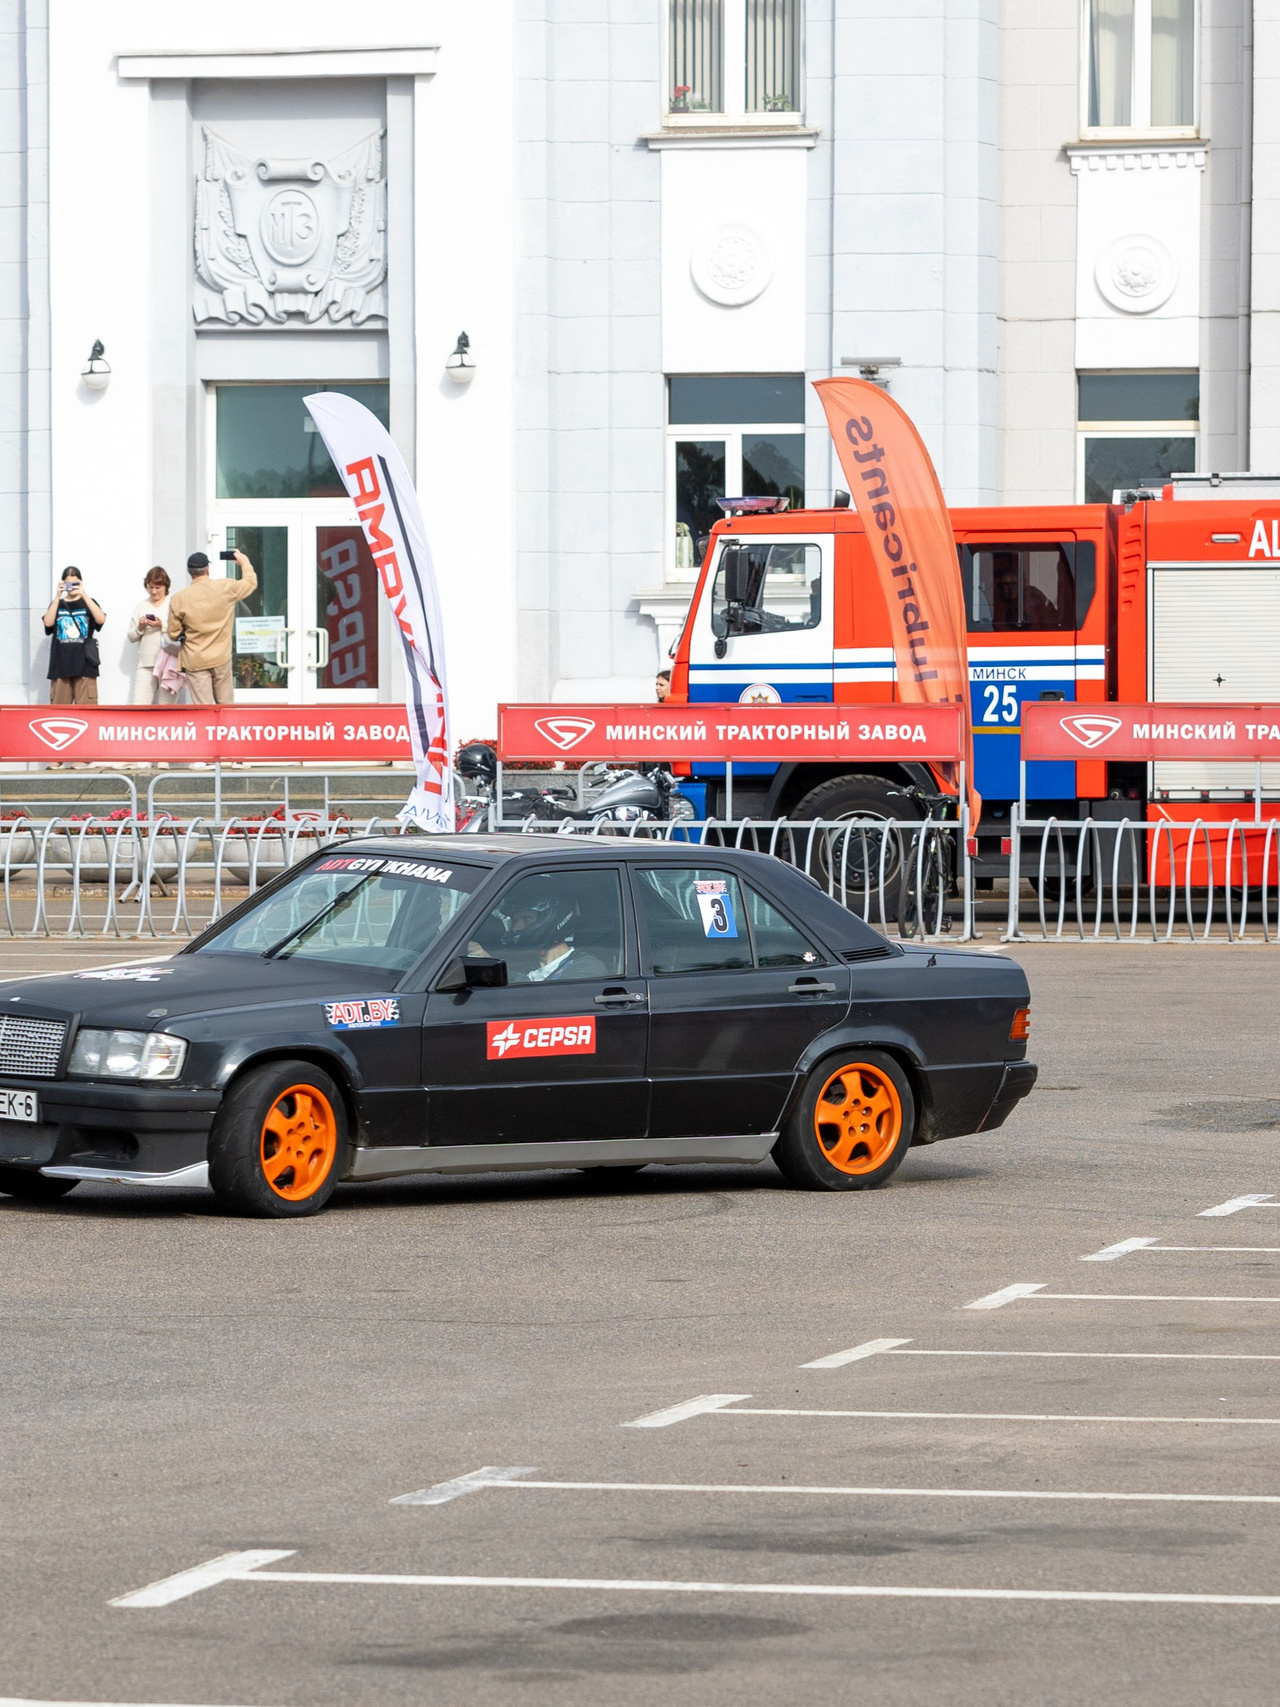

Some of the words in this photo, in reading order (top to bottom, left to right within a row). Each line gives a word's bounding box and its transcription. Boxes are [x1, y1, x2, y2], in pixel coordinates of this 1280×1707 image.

[972, 667, 1027, 680] МИНСК
[982, 684, 1018, 722] 25
[98, 721, 197, 742] МИНСКИЙ
[205, 721, 335, 742] ТРАКТОРНЫЙ
[343, 724, 409, 742] ЗАВОД
[606, 720, 707, 741] МИНСКИЙ
[716, 721, 850, 741] ТРАКТОРНЫЙ
[858, 724, 926, 743] ЗАВОД
[1132, 721, 1236, 740] МИНСКИЙ
[710, 898, 728, 932] 3
[331, 999, 393, 1024] ADT.BY
[523, 1025, 592, 1048] CEPSA
